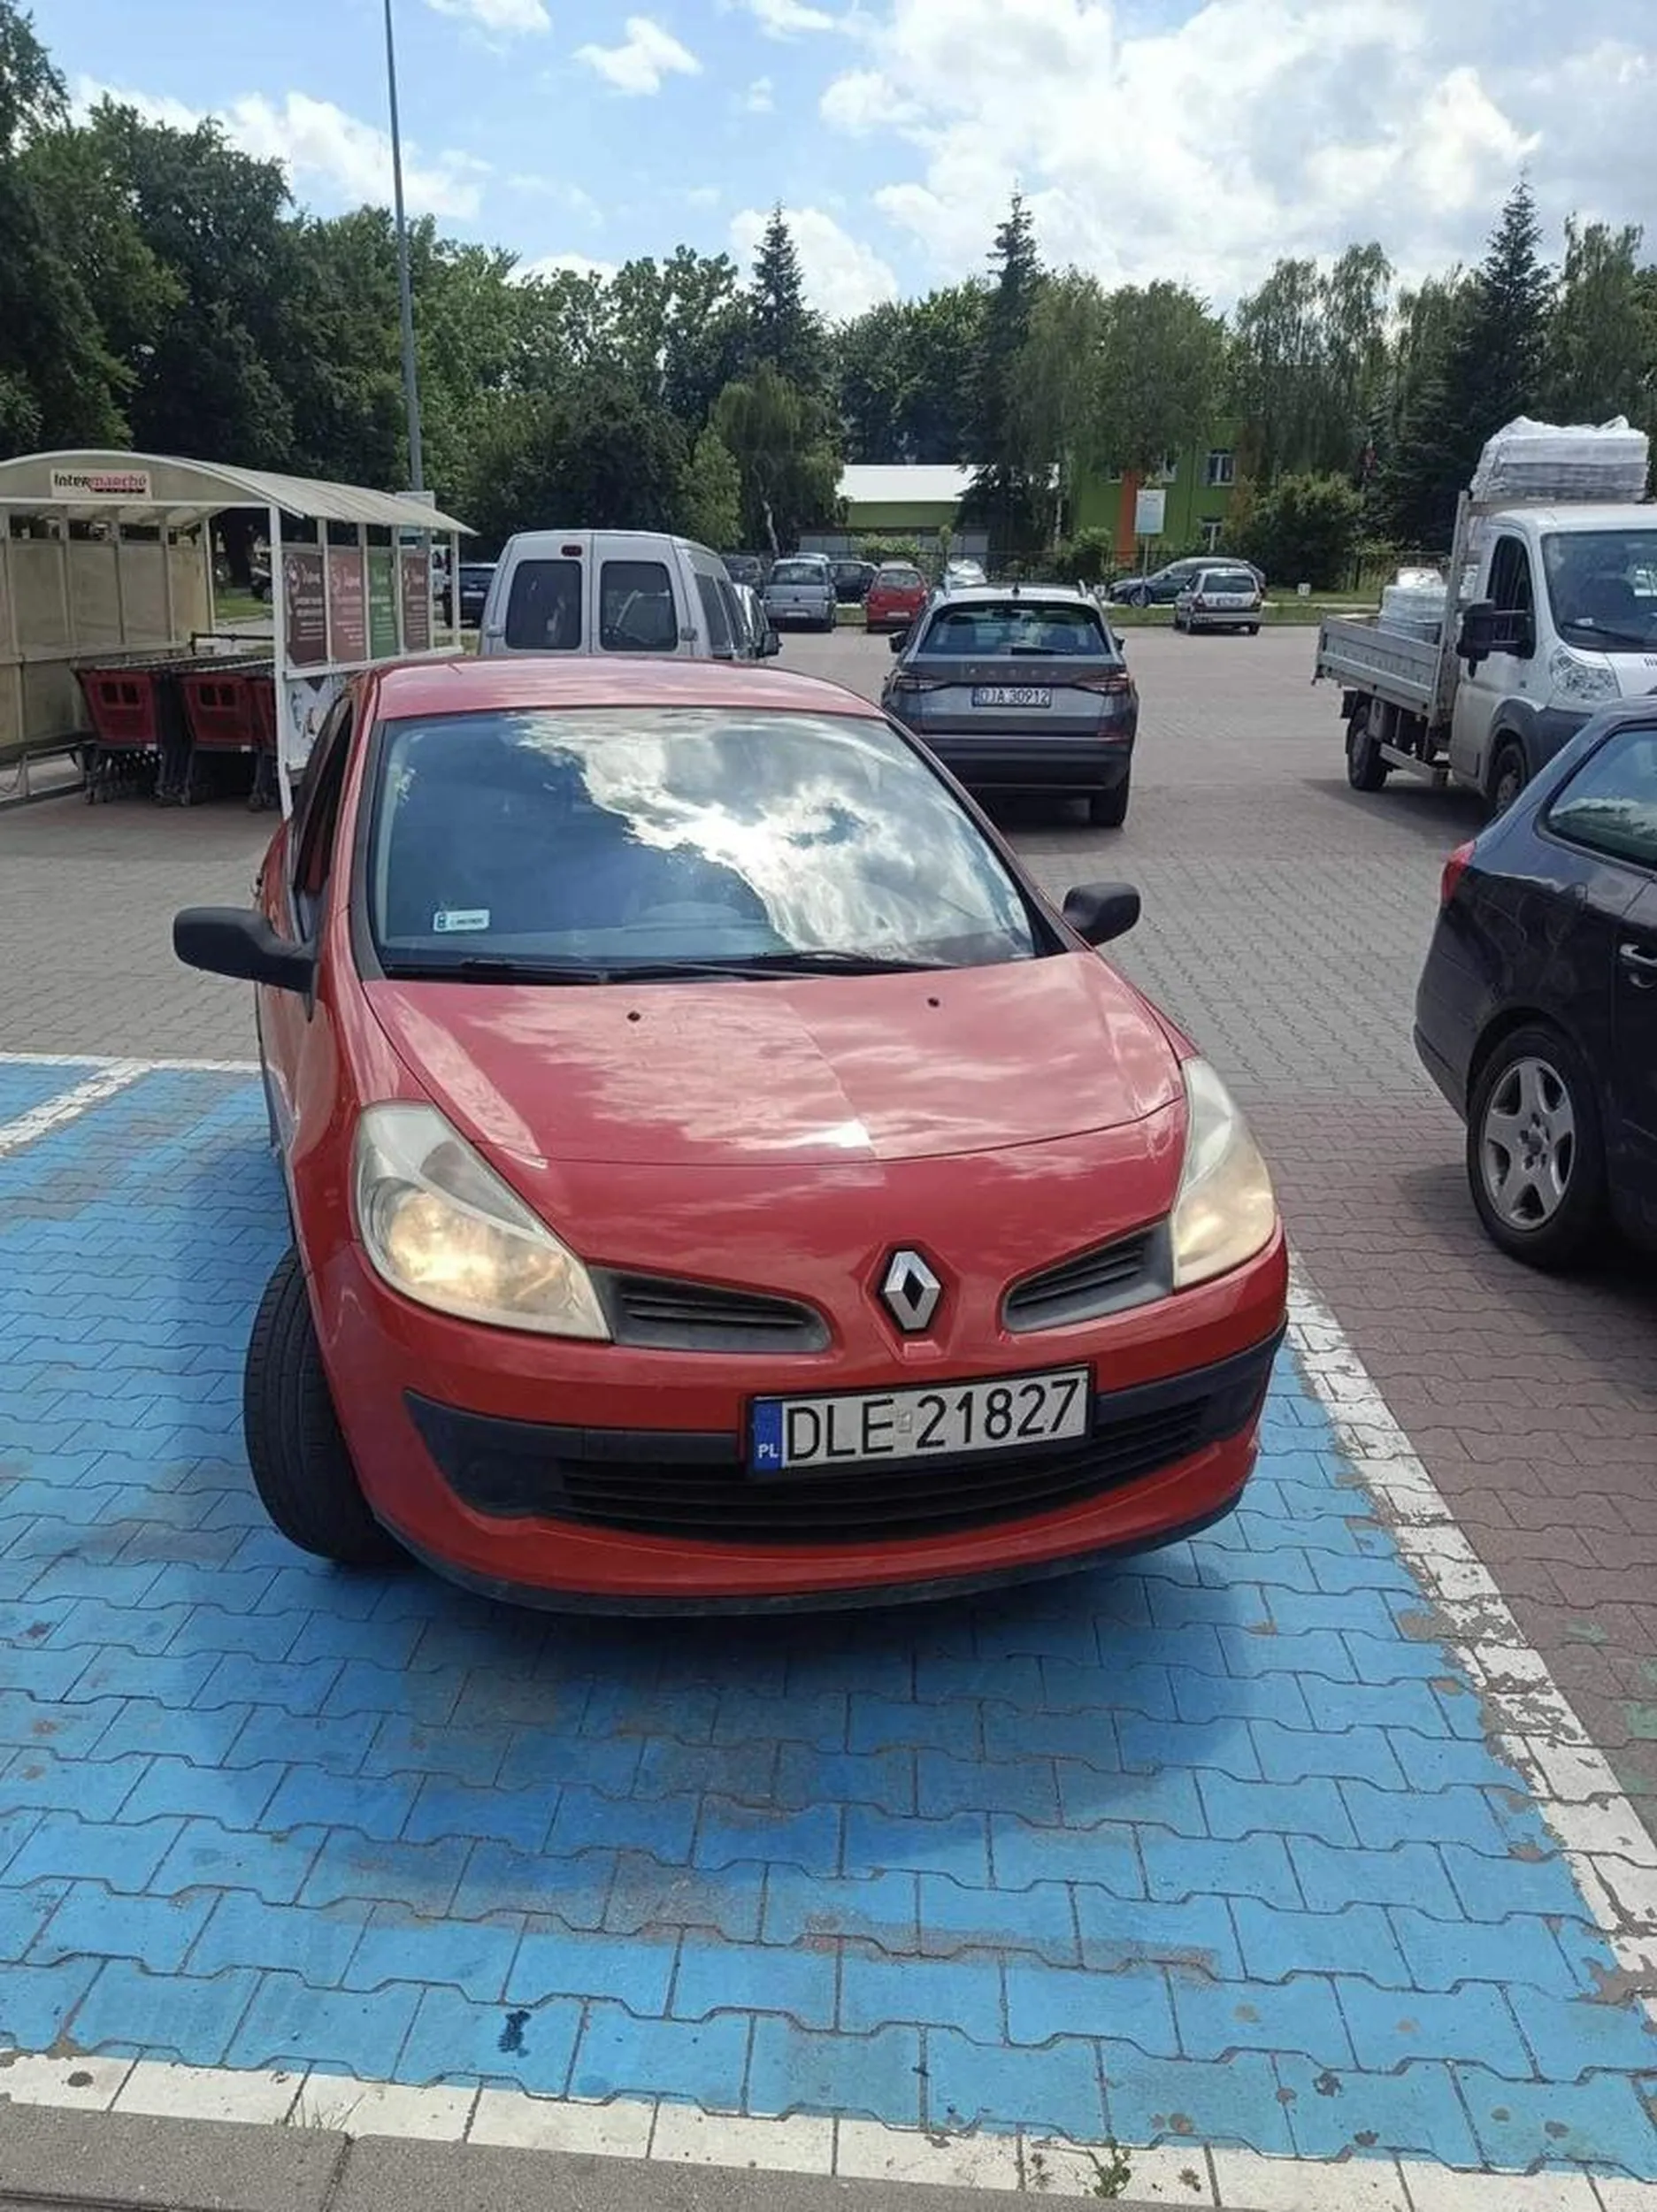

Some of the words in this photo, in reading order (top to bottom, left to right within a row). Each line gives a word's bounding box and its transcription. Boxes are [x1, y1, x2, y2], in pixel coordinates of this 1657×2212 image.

[1009, 688, 1049, 705] 30912
[786, 1397, 894, 1462] DLE
[916, 1378, 1080, 1449] 21827
[758, 1443, 780, 1459] PL
